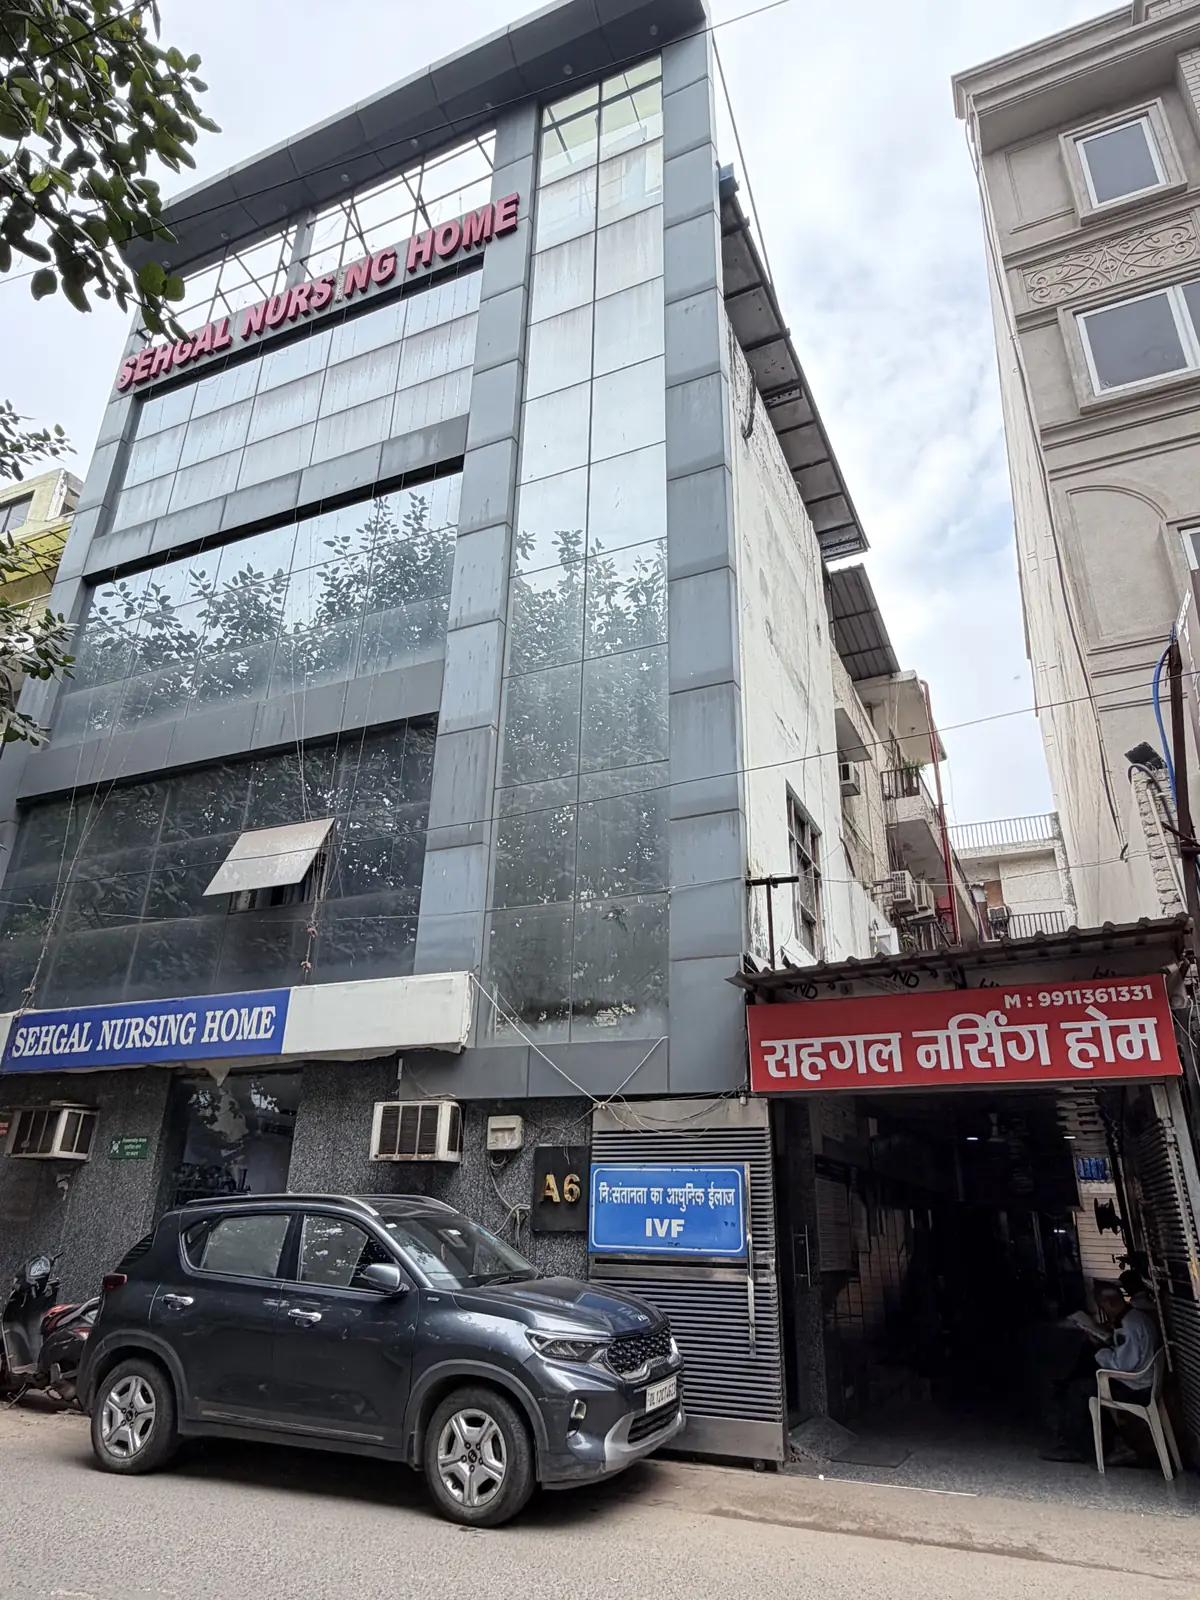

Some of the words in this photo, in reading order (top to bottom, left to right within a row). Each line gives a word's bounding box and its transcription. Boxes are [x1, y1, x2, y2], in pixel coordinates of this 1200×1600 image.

[116, 317, 233, 392] SEHGAL
[241, 247, 397, 341] NURSNG
[405, 192, 520, 274] HOME
[1004, 994, 1021, 1009] M
[1037, 985, 1153, 1007] 9911361331
[12, 1022, 92, 1057] SEHGAL
[96, 1012, 197, 1051] NURSING
[200, 1006, 276, 1043] HOME
[760, 1031, 903, 1081] सहगल
[912, 1010, 1051, 1070] नर्सिंग
[1059, 1005, 1162, 1069] होम
[541, 1174, 580, 1203] A6
[650, 1187, 664, 1205] का
[707, 1182, 736, 1209] ईलाज
[645, 1218, 685, 1238] IVF
